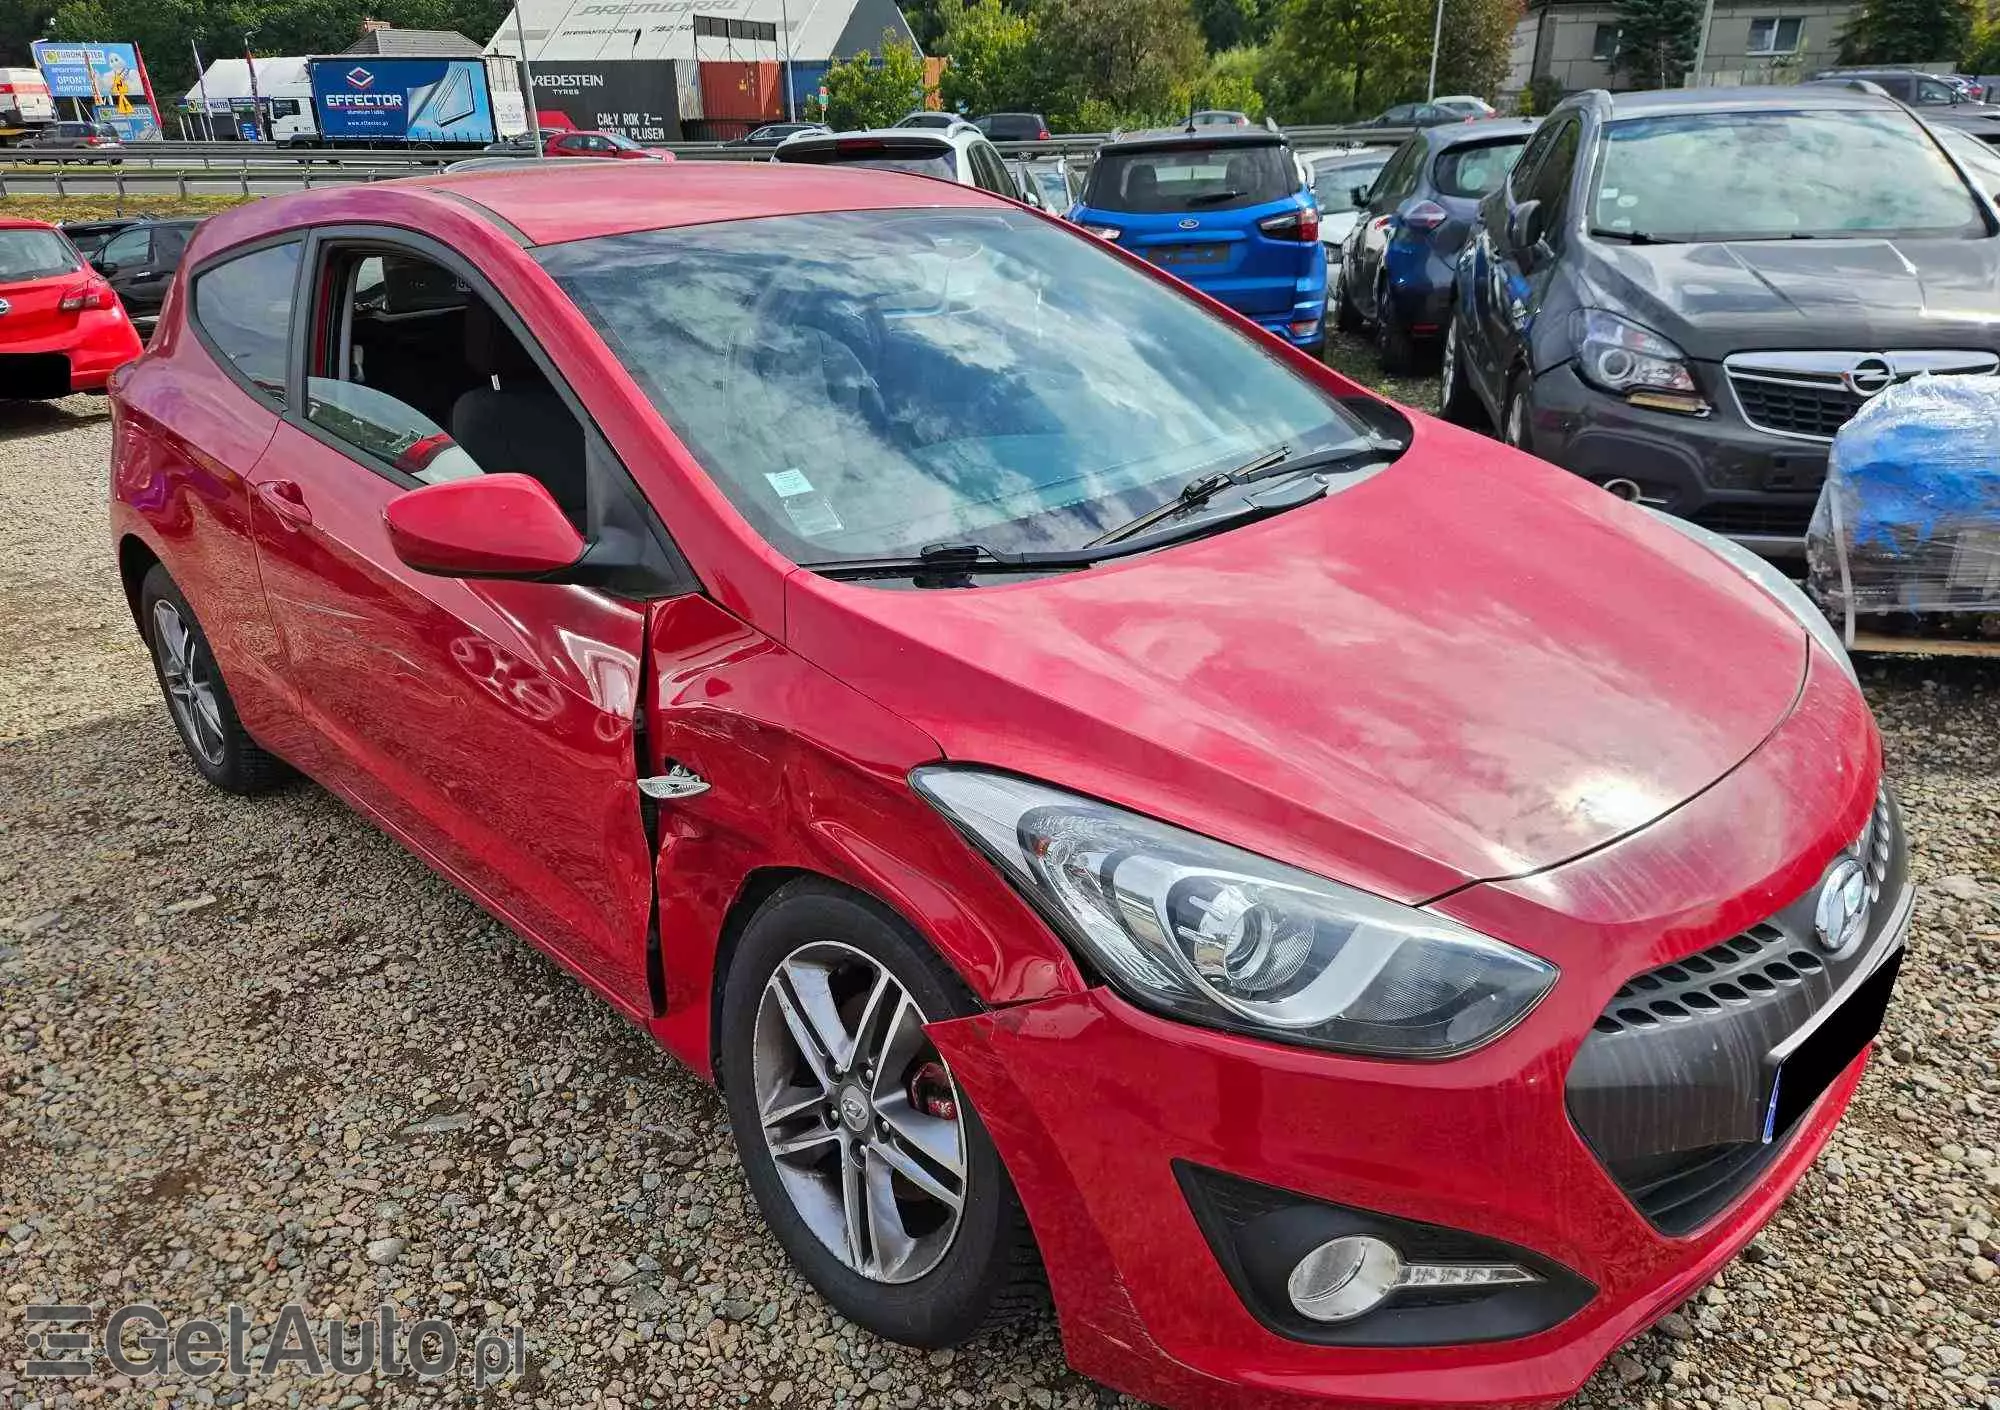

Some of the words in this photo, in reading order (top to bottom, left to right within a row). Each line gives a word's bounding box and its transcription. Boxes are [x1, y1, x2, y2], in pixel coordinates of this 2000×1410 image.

[531, 74, 604, 87] VREDESTEIN
[325, 94, 403, 106] EFFECTOR
[597, 112, 619, 126] CAŁY
[623, 112, 640, 126] ROK
[631, 127, 665, 140] PLUSEM
